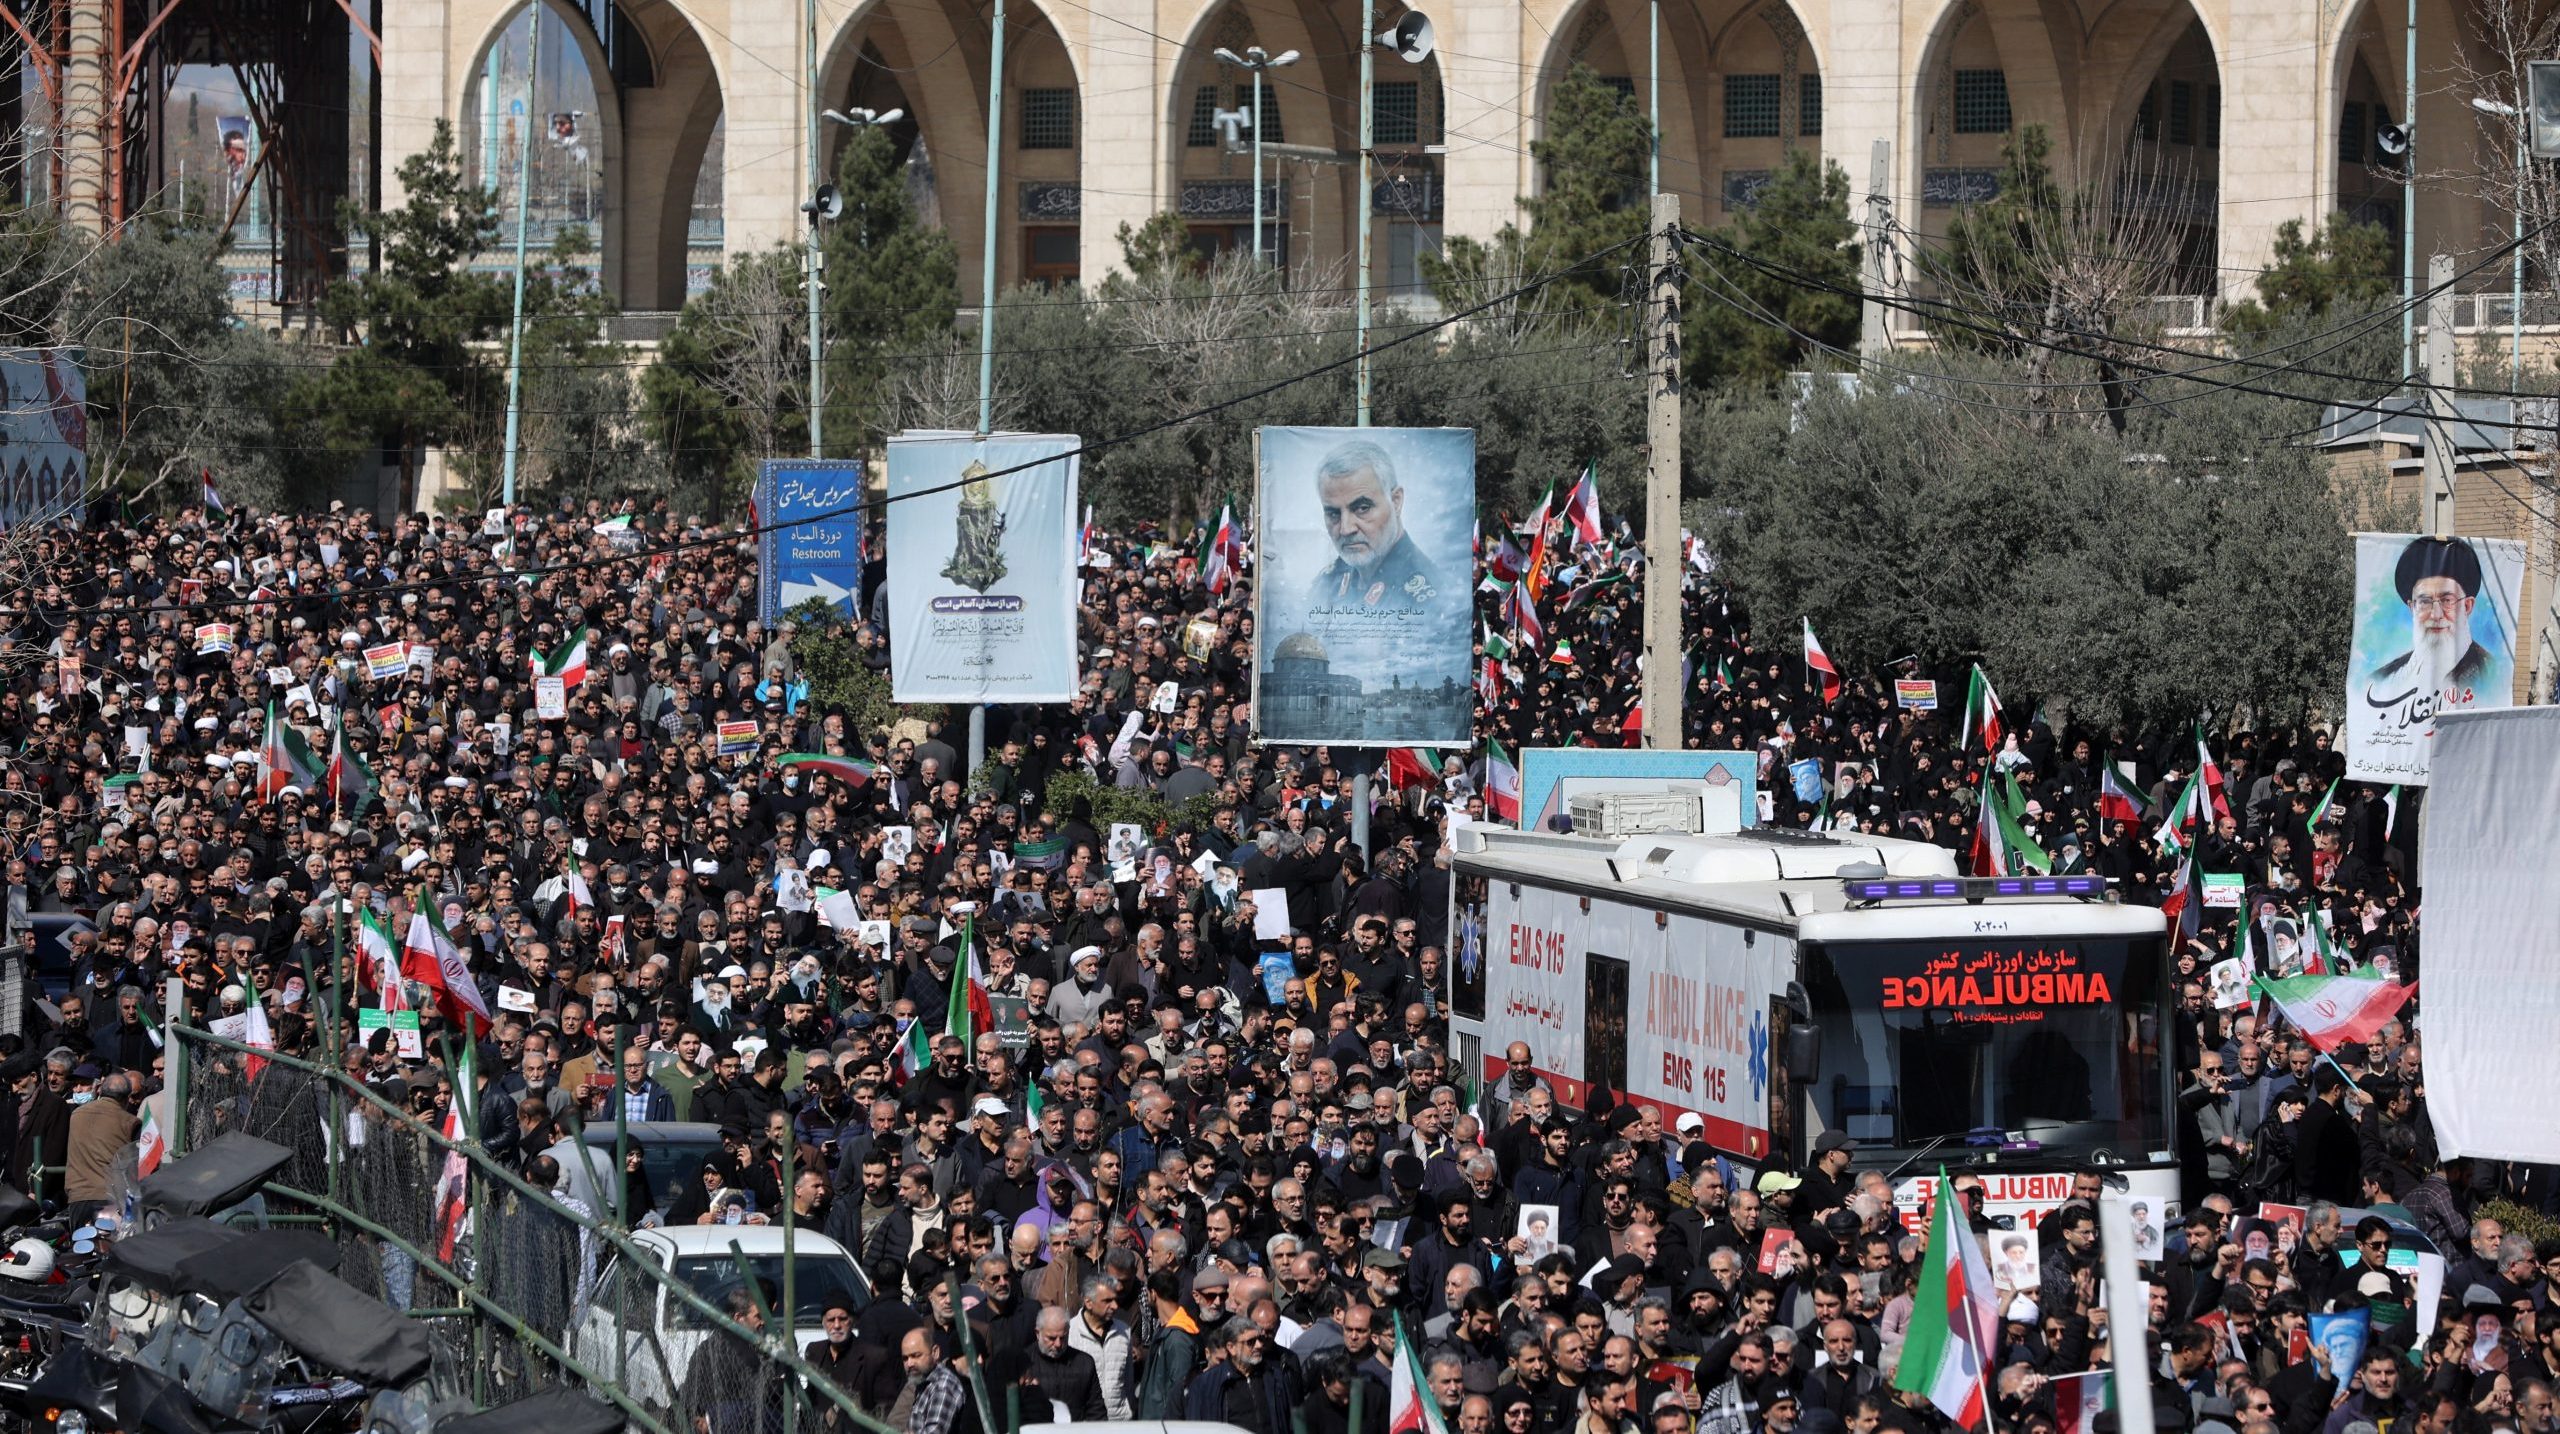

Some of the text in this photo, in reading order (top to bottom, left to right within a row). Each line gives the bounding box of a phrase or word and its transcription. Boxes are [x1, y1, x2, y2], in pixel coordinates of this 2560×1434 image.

[779, 480, 854, 508] سرویس بهداشتی
[792, 547, 840, 559] Restroom
[935, 599, 952, 609] است
[998, 599, 1006, 609] از
[1006, 600, 1019, 610] پس
[1308, 606, 1425, 620] مدافع حرم بزرگ عالم اسلام
[2354, 759, 2373, 771] بزرگ
[2373, 761, 2395, 774] تهران
[1510, 924, 1565, 975] E.M.S 115
[1923, 949, 2076, 975] سازمان اورژانس کشور
[1647, 971, 1745, 1055] AMBULANCE
[2015, 1011, 2044, 1021] انتقادات
[1663, 1052, 1726, 1103] EMS 115
